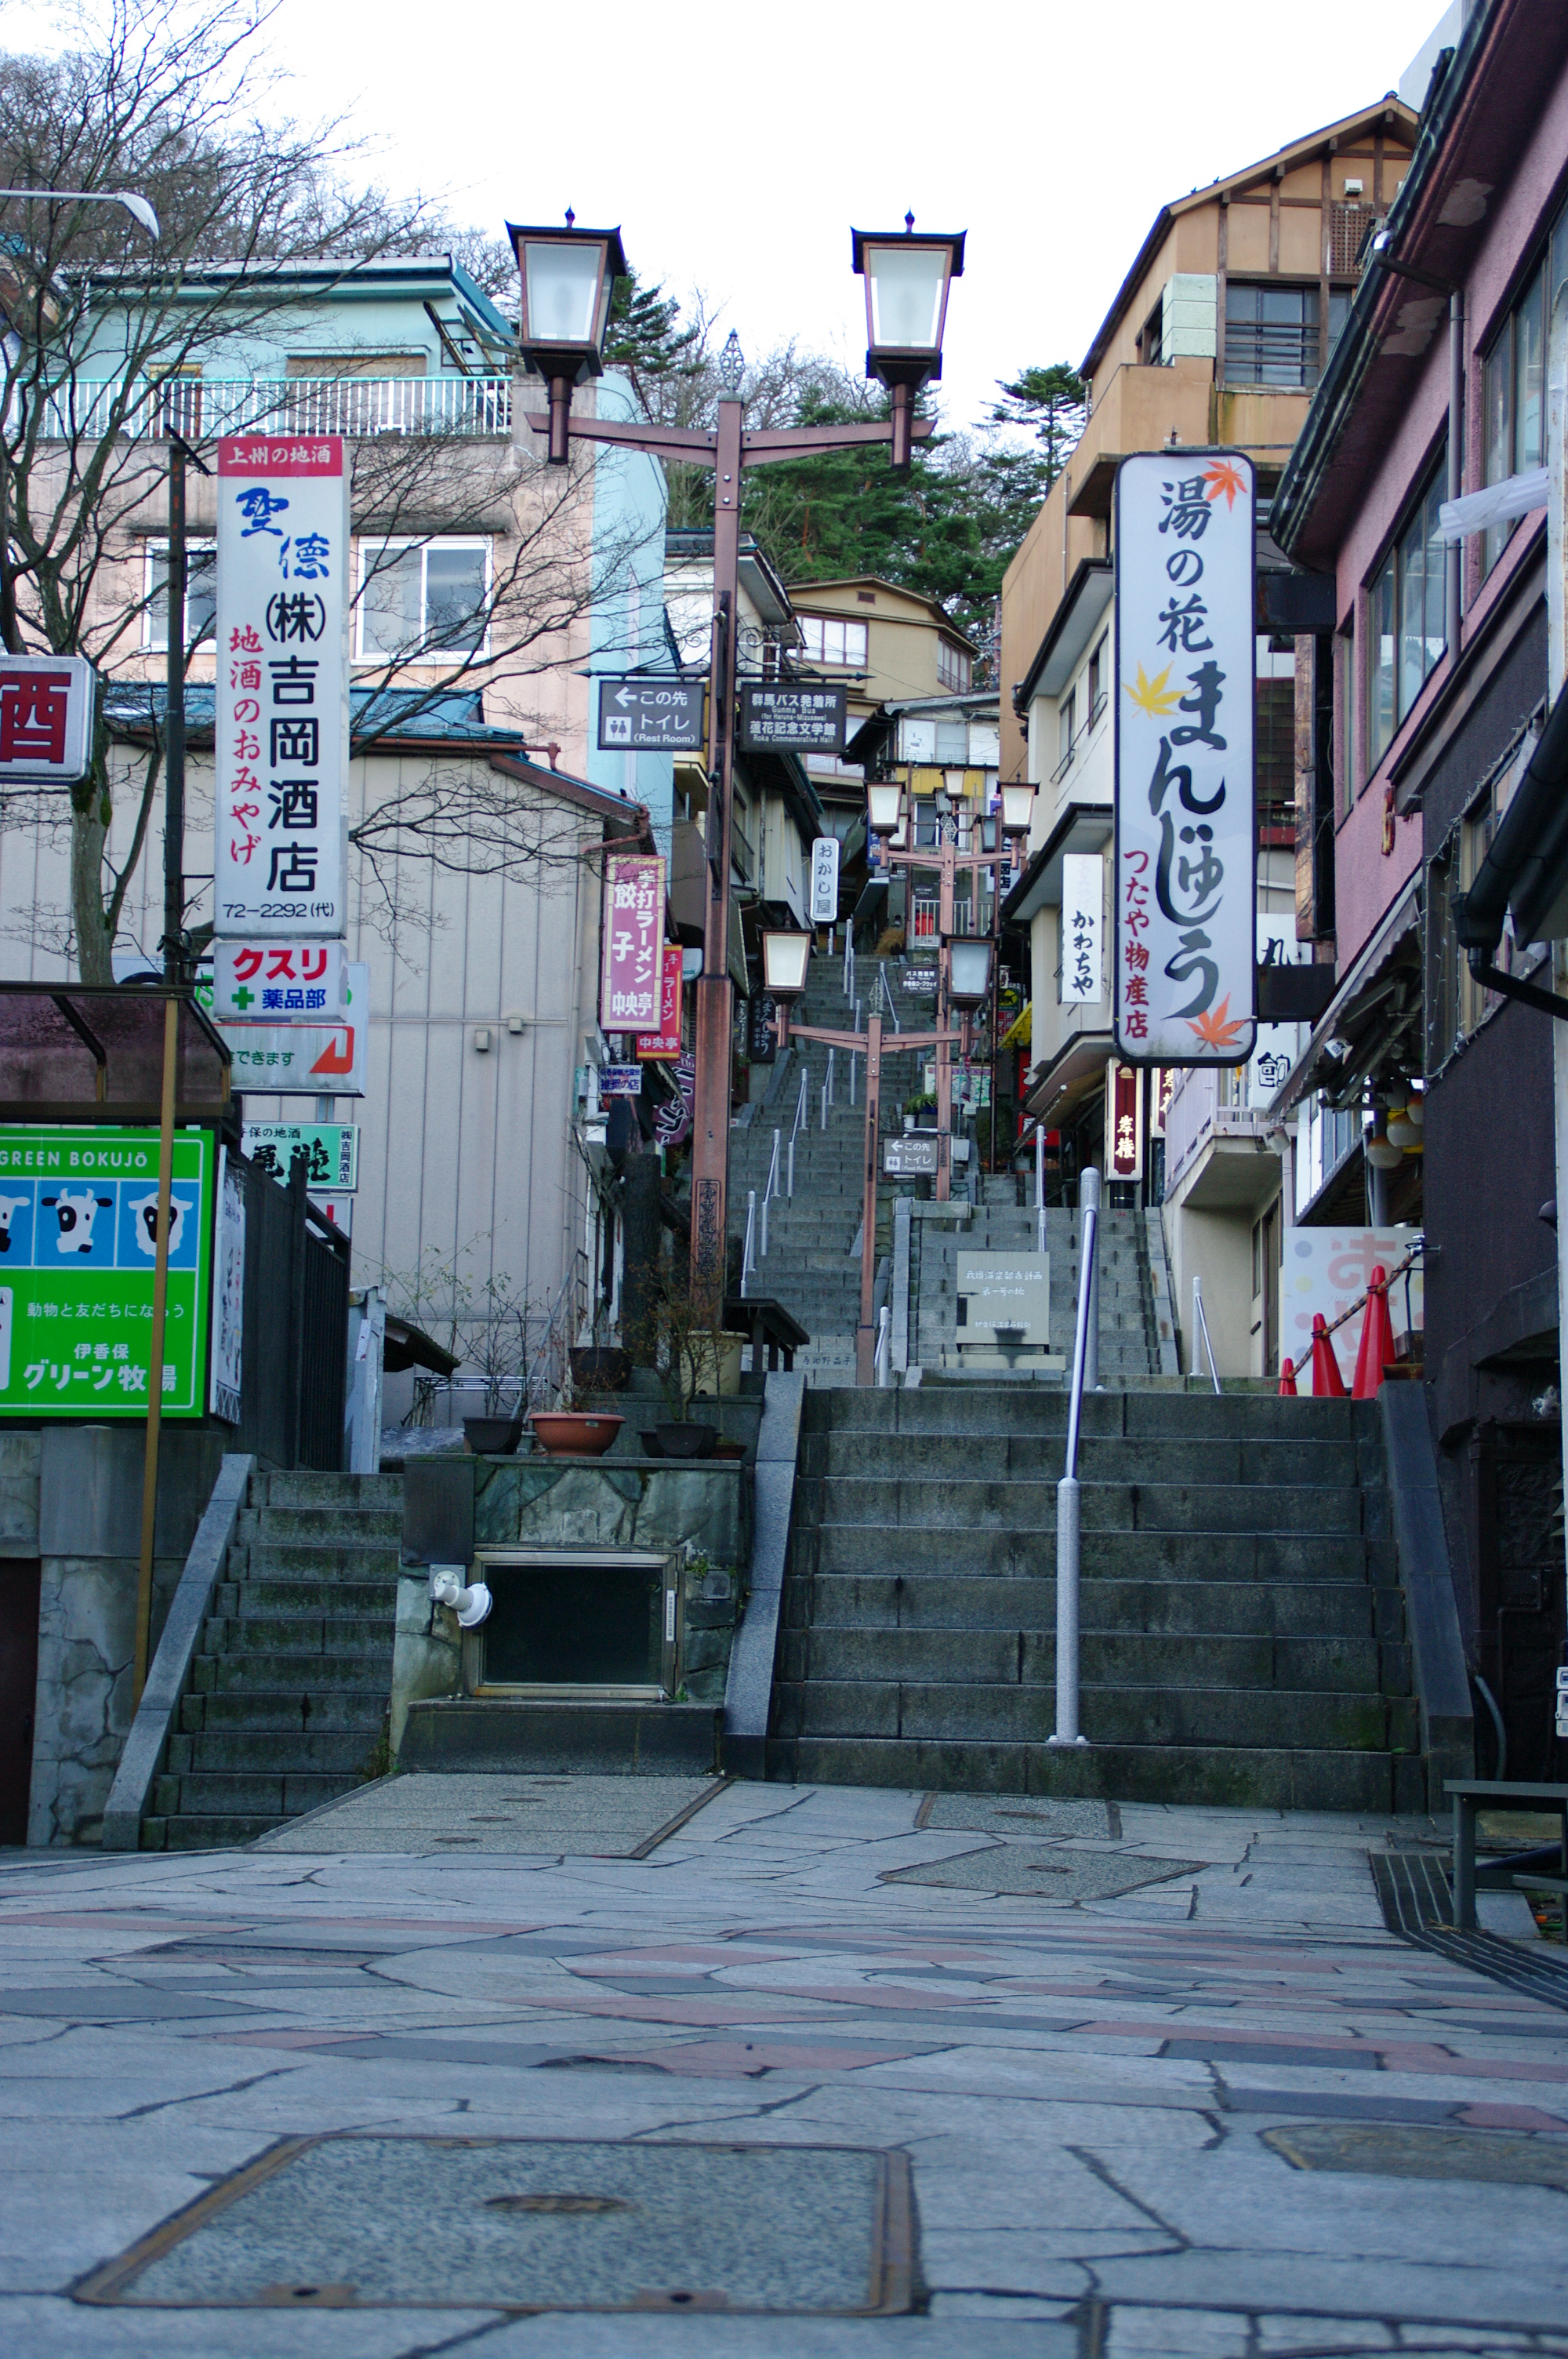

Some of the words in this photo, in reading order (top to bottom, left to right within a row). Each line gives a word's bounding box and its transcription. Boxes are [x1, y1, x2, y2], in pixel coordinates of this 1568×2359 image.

[227, 445, 331, 465] 上州の地酒
[640, 690, 688, 707] この先
[751, 692, 837, 708] 群馬バス発着所
[640, 714, 690, 730] トイレ
[229, 624, 263, 866] 地酒のおみやげ
[633, 733, 661, 743] (Rest
[662, 734, 696, 745] Room)
[816, 844, 833, 914] おかし屋
[612, 881, 637, 961] 餃子
[634, 870, 656, 983] 手打ラーメン
[1071, 910, 1094, 997] かわちや
[1123, 849, 1149, 1038] つたや物産店
[233, 947, 327, 982] クスリ
[262, 988, 326, 1009] 薬品部
[612, 991, 653, 1017] 中央亭
[638, 1036, 679, 1050] 中央亭
[904, 1142, 931, 1151] この先
[1114, 1114, 1136, 1159] 岸権
[0, 1150, 60, 1166] GREEN
[69, 1151, 147, 1167] BOKUJŌ
[904, 1154, 931, 1165] トイレ
[27, 1302, 185, 1318] 動物と友だちになう
[73, 1343, 129, 1360] 伊香保
